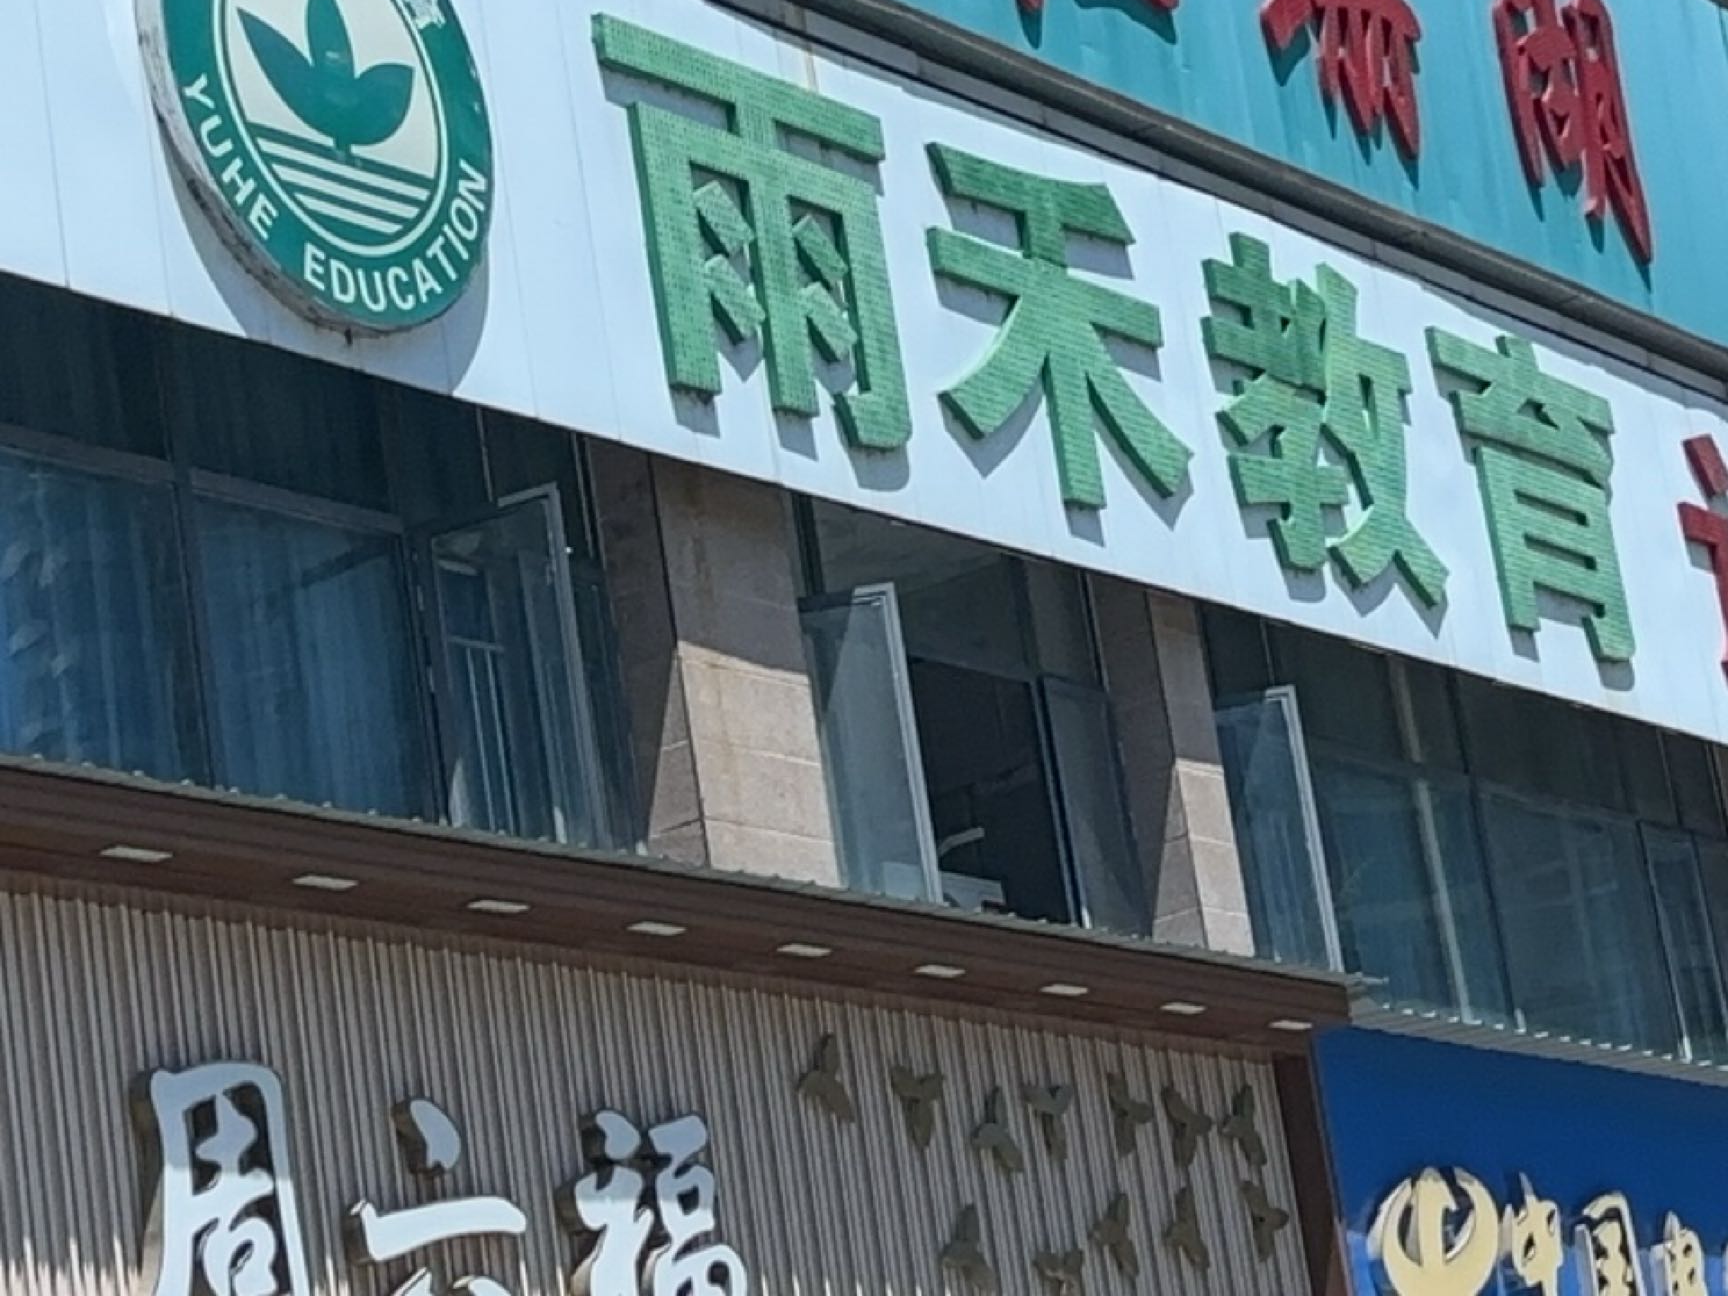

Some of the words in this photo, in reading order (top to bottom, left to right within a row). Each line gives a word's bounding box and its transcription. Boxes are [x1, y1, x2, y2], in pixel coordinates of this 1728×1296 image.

[181, 71, 280, 241] YUHE
[302, 158, 489, 313] EDUCATION
[592, 12, 1636, 663] 雨禾教育
[149, 1059, 748, 1296] 周六福
